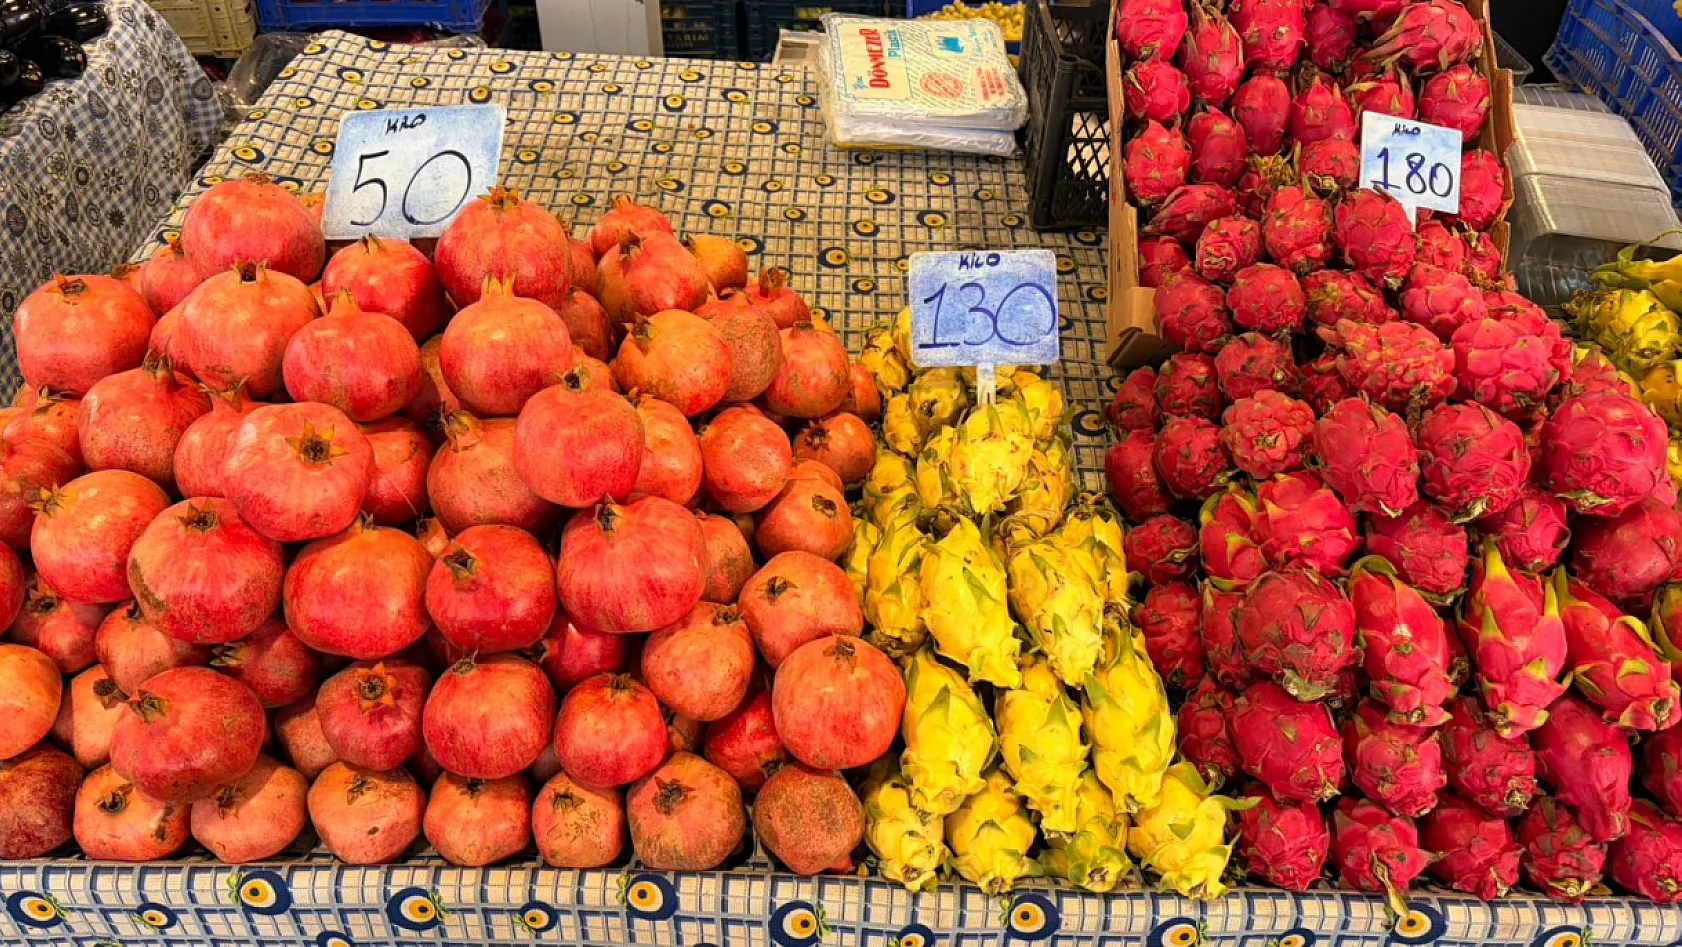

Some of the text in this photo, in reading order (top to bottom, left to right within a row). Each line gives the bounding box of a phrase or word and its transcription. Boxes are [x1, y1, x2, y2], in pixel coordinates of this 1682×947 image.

[351, 149, 472, 226] 50
[1370, 146, 1454, 198] 180
[918, 282, 1056, 349] 130
